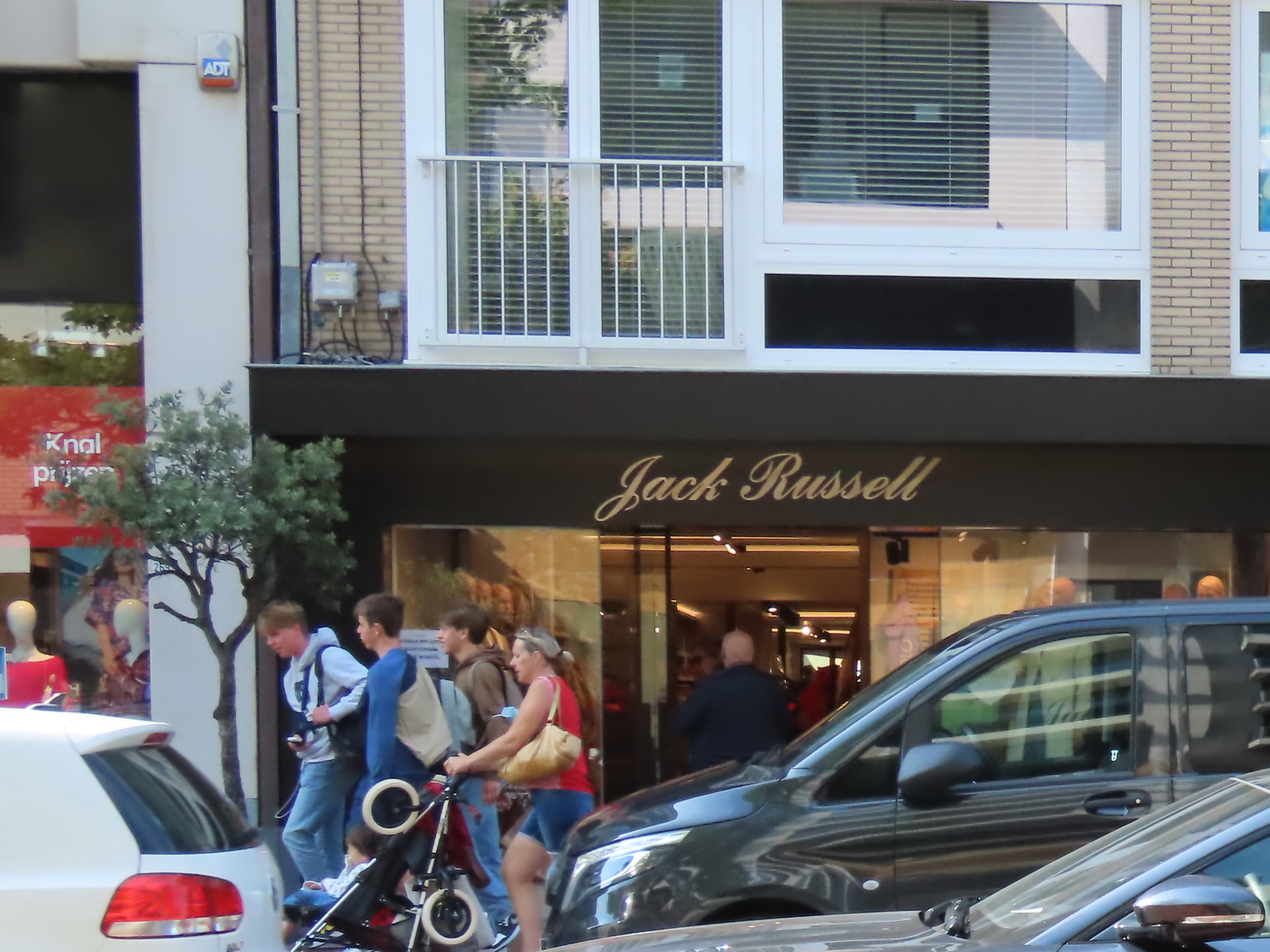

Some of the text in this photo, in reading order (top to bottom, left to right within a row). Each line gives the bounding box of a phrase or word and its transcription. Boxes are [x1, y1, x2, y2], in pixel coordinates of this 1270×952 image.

[204, 61, 230, 77] ADT
[46, 432, 102, 454] Knal
[594, 452, 942, 522] Jack Russell
